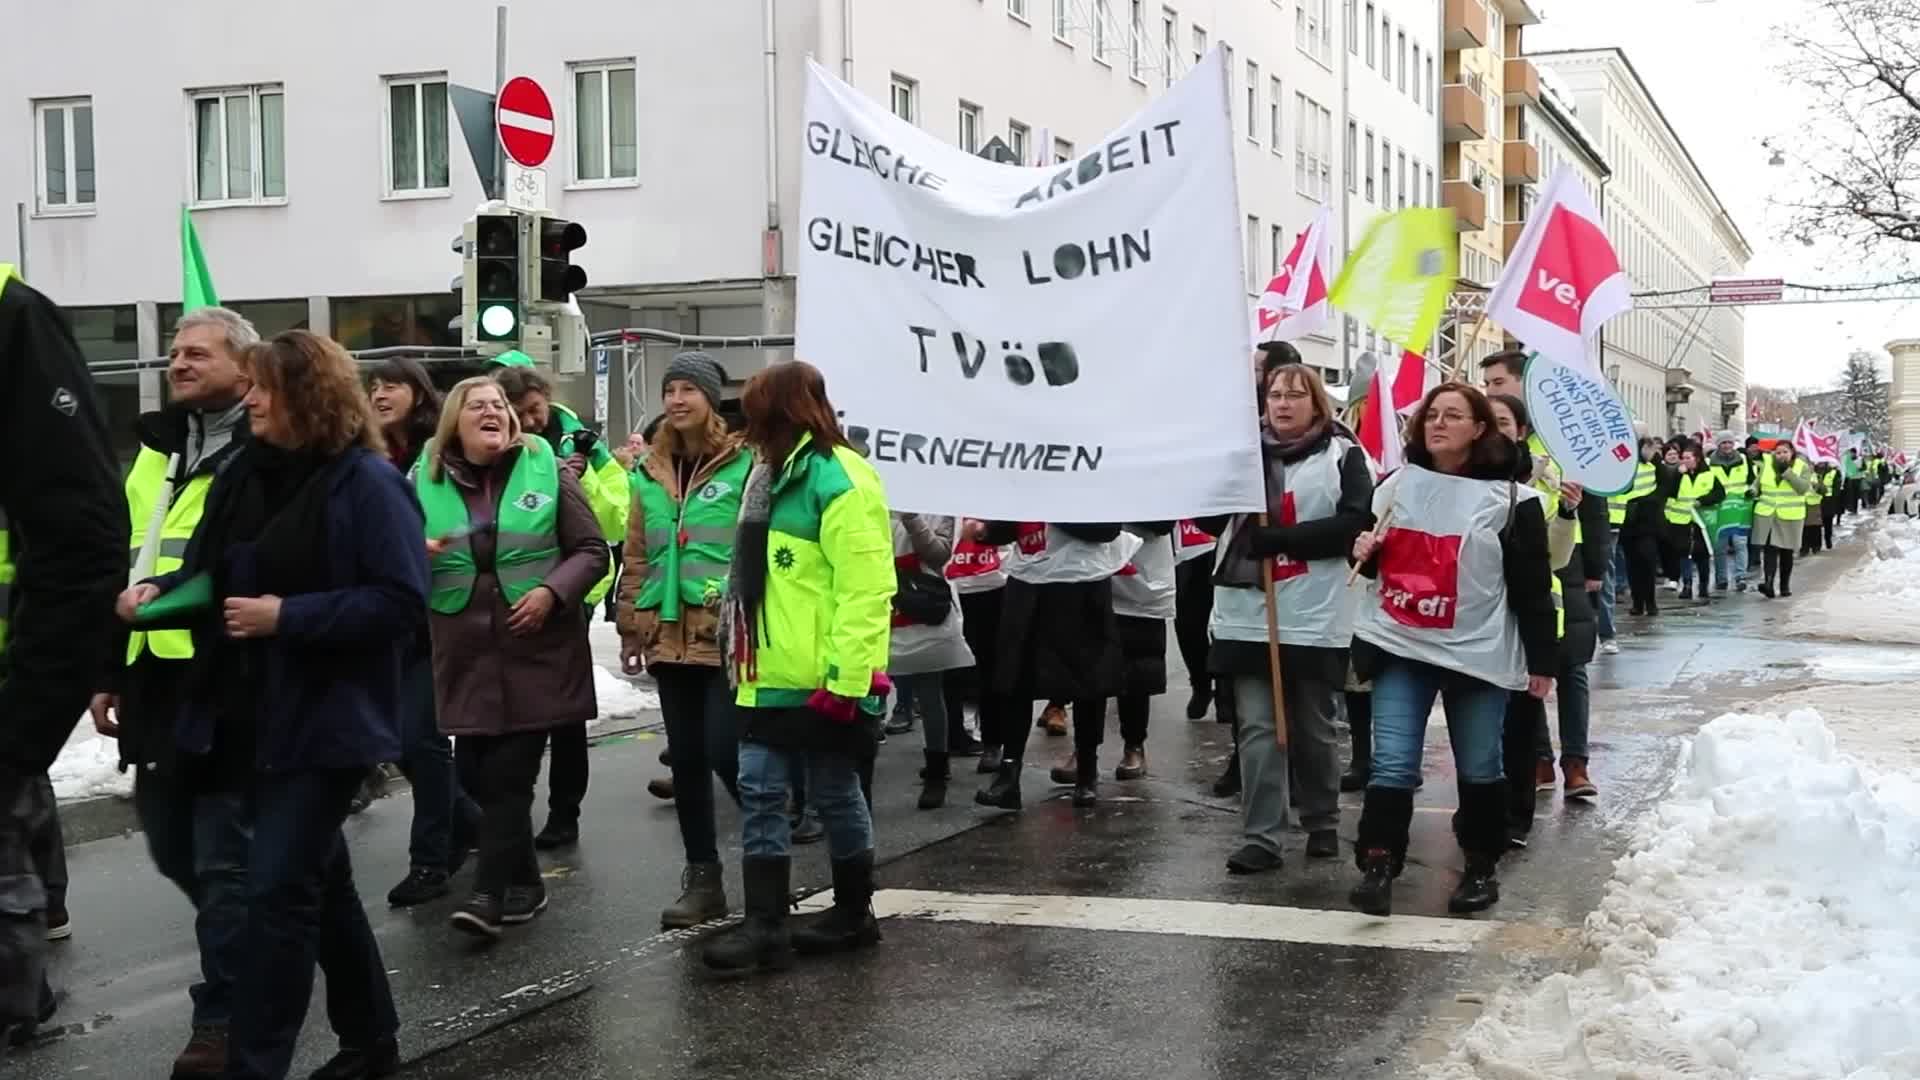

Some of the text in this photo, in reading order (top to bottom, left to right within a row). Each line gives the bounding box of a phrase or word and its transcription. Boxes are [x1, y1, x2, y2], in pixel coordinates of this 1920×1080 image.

[807, 120, 1180, 208] GLEICHE ARBEIT
[808, 217, 1151, 288] GLEICHER LOHN
[836, 410, 1103, 472] BERNEHMEN
